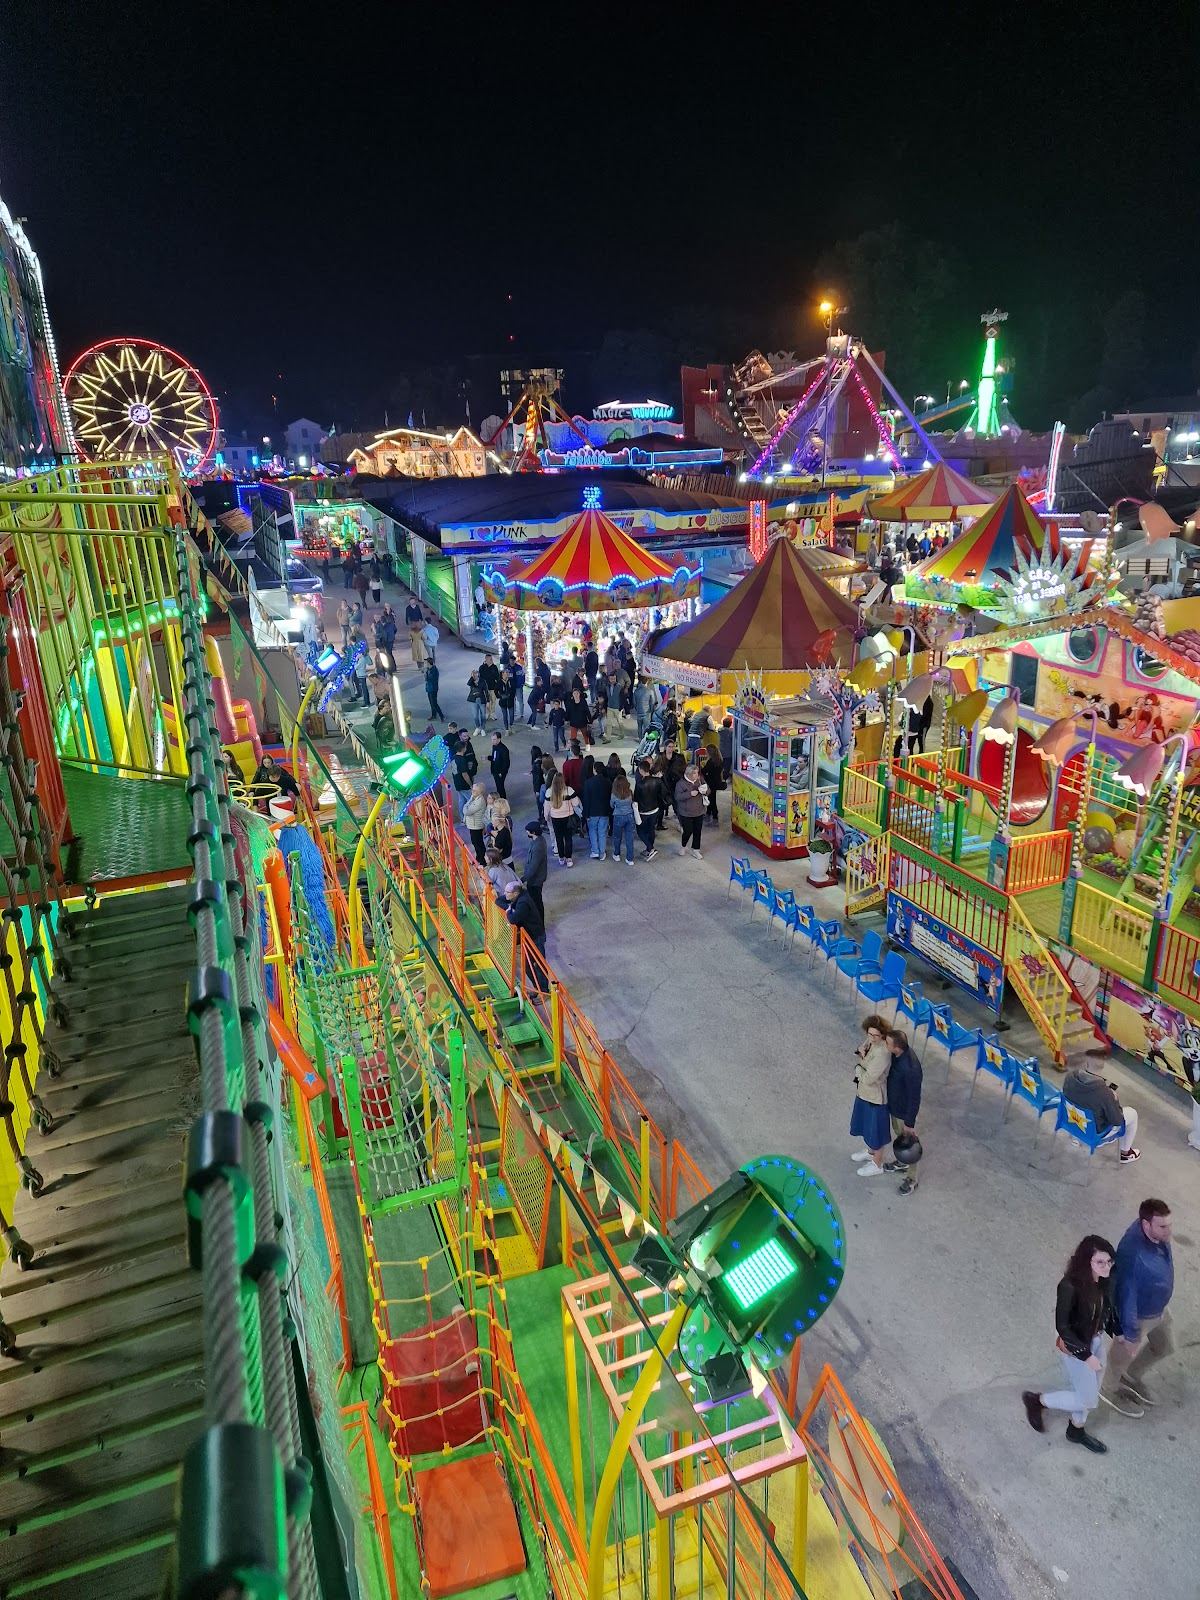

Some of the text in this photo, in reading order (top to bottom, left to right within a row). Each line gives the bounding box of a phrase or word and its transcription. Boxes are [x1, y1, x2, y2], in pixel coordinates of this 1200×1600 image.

[592, 407, 624, 419] MAGIC
[708, 513, 747, 526] DISCO
[469, 524, 528, 541] I PUNK
[802, 538, 828, 547] Salato
